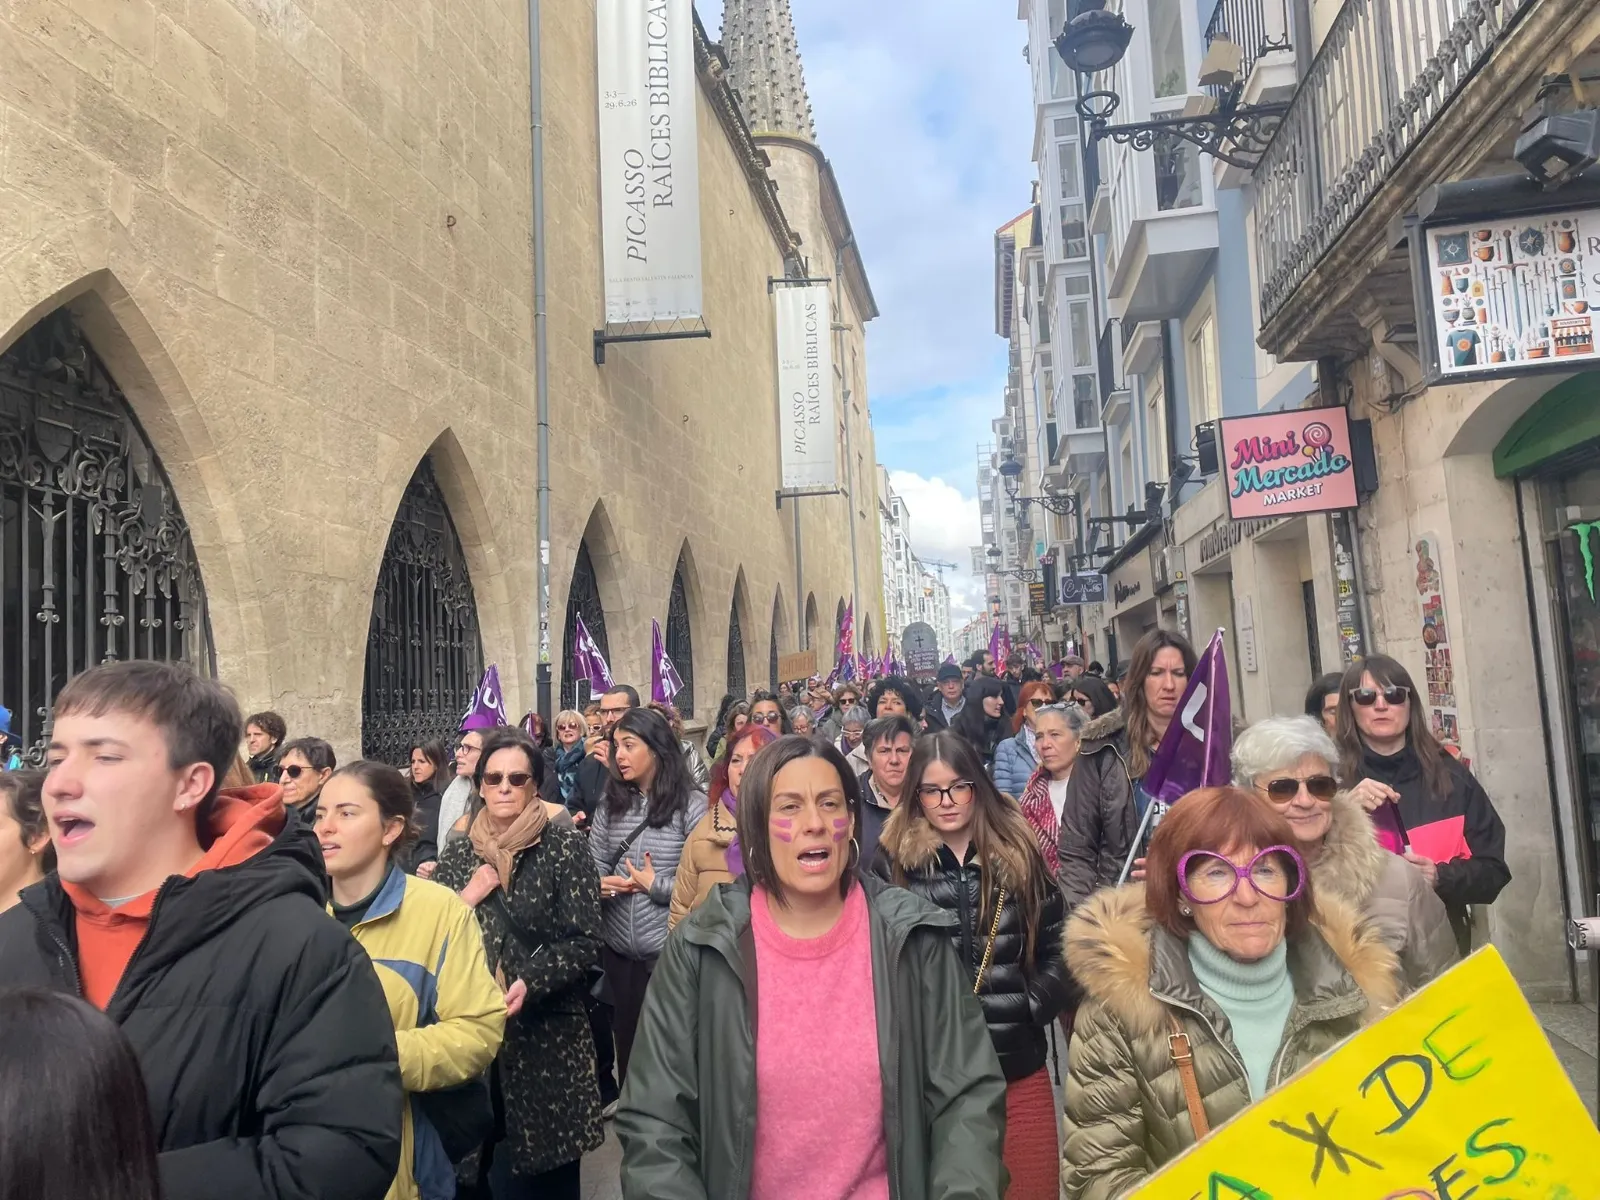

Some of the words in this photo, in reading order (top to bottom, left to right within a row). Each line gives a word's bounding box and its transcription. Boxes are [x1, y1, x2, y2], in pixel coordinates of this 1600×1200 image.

[645, 0, 669, 107] BÍBLICA
[604, 98, 638, 110] 29.6.26
[647, 113, 673, 209] RAÍCES
[624, 149, 647, 264] PICASSO
[804, 303, 818, 369] BÍBLICAS
[793, 391, 807, 455] PICASSO
[807, 373, 820, 425] RAÍCES
[1231, 430, 1300, 470] Mini
[1231, 452, 1351, 498] Mercado
[1263, 482, 1323, 506] MARKET
[1357, 1004, 1492, 1136] DE
